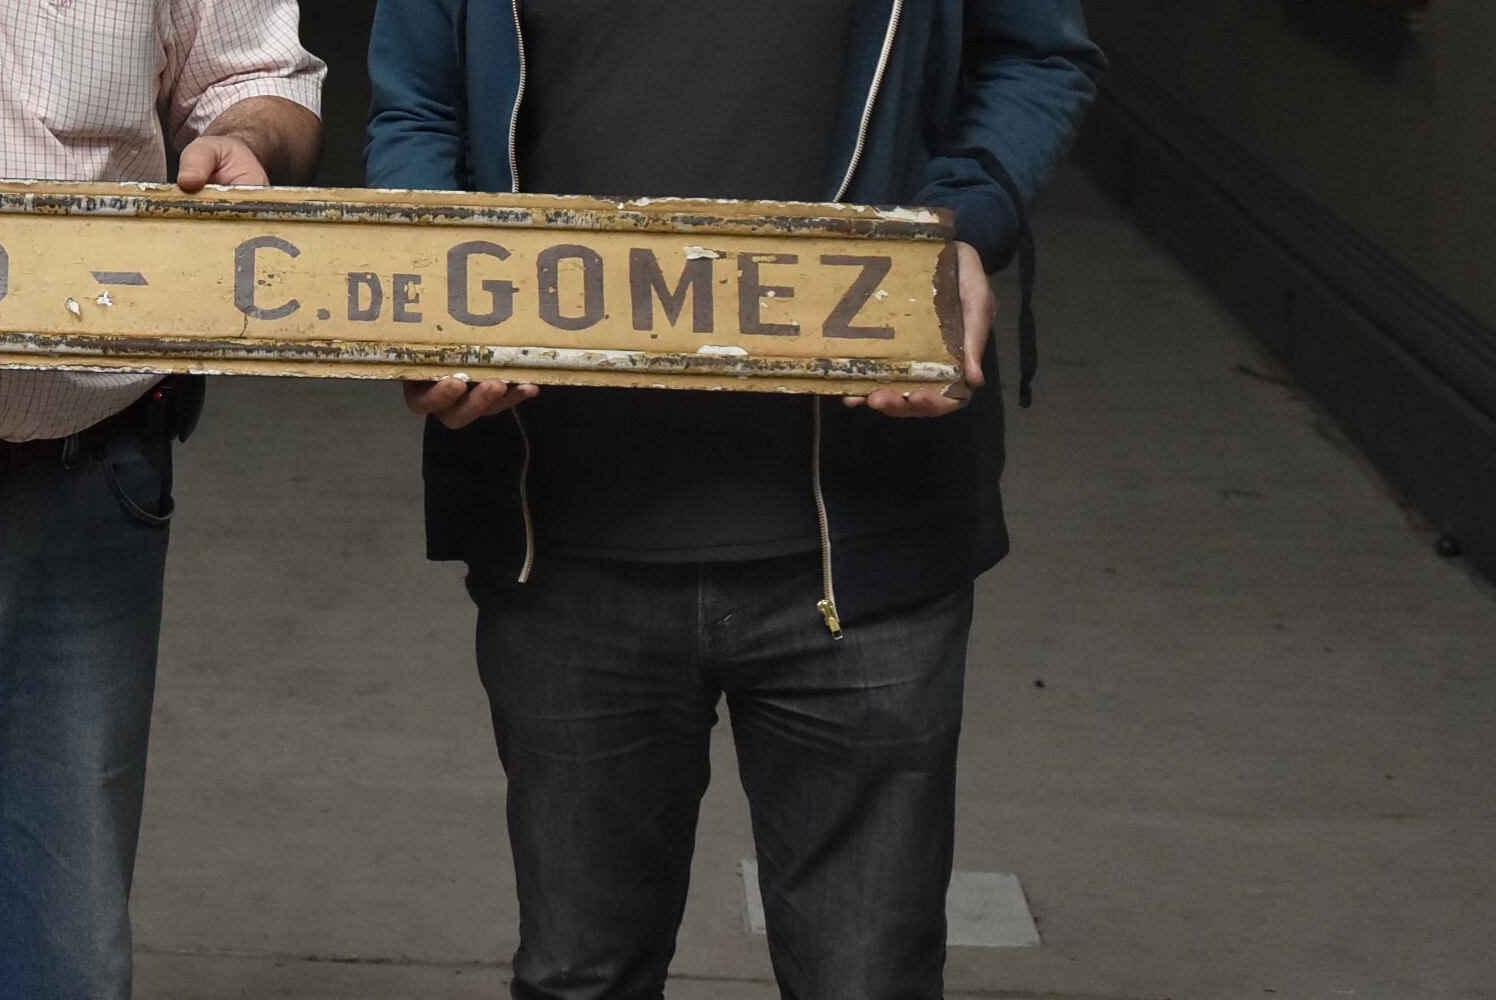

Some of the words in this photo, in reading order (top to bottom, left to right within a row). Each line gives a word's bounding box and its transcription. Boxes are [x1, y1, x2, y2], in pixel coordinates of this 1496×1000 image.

[90, 270, 149, 286] -
[346, 271, 422, 323] DE
[446, 240, 895, 340] GOMEZ
